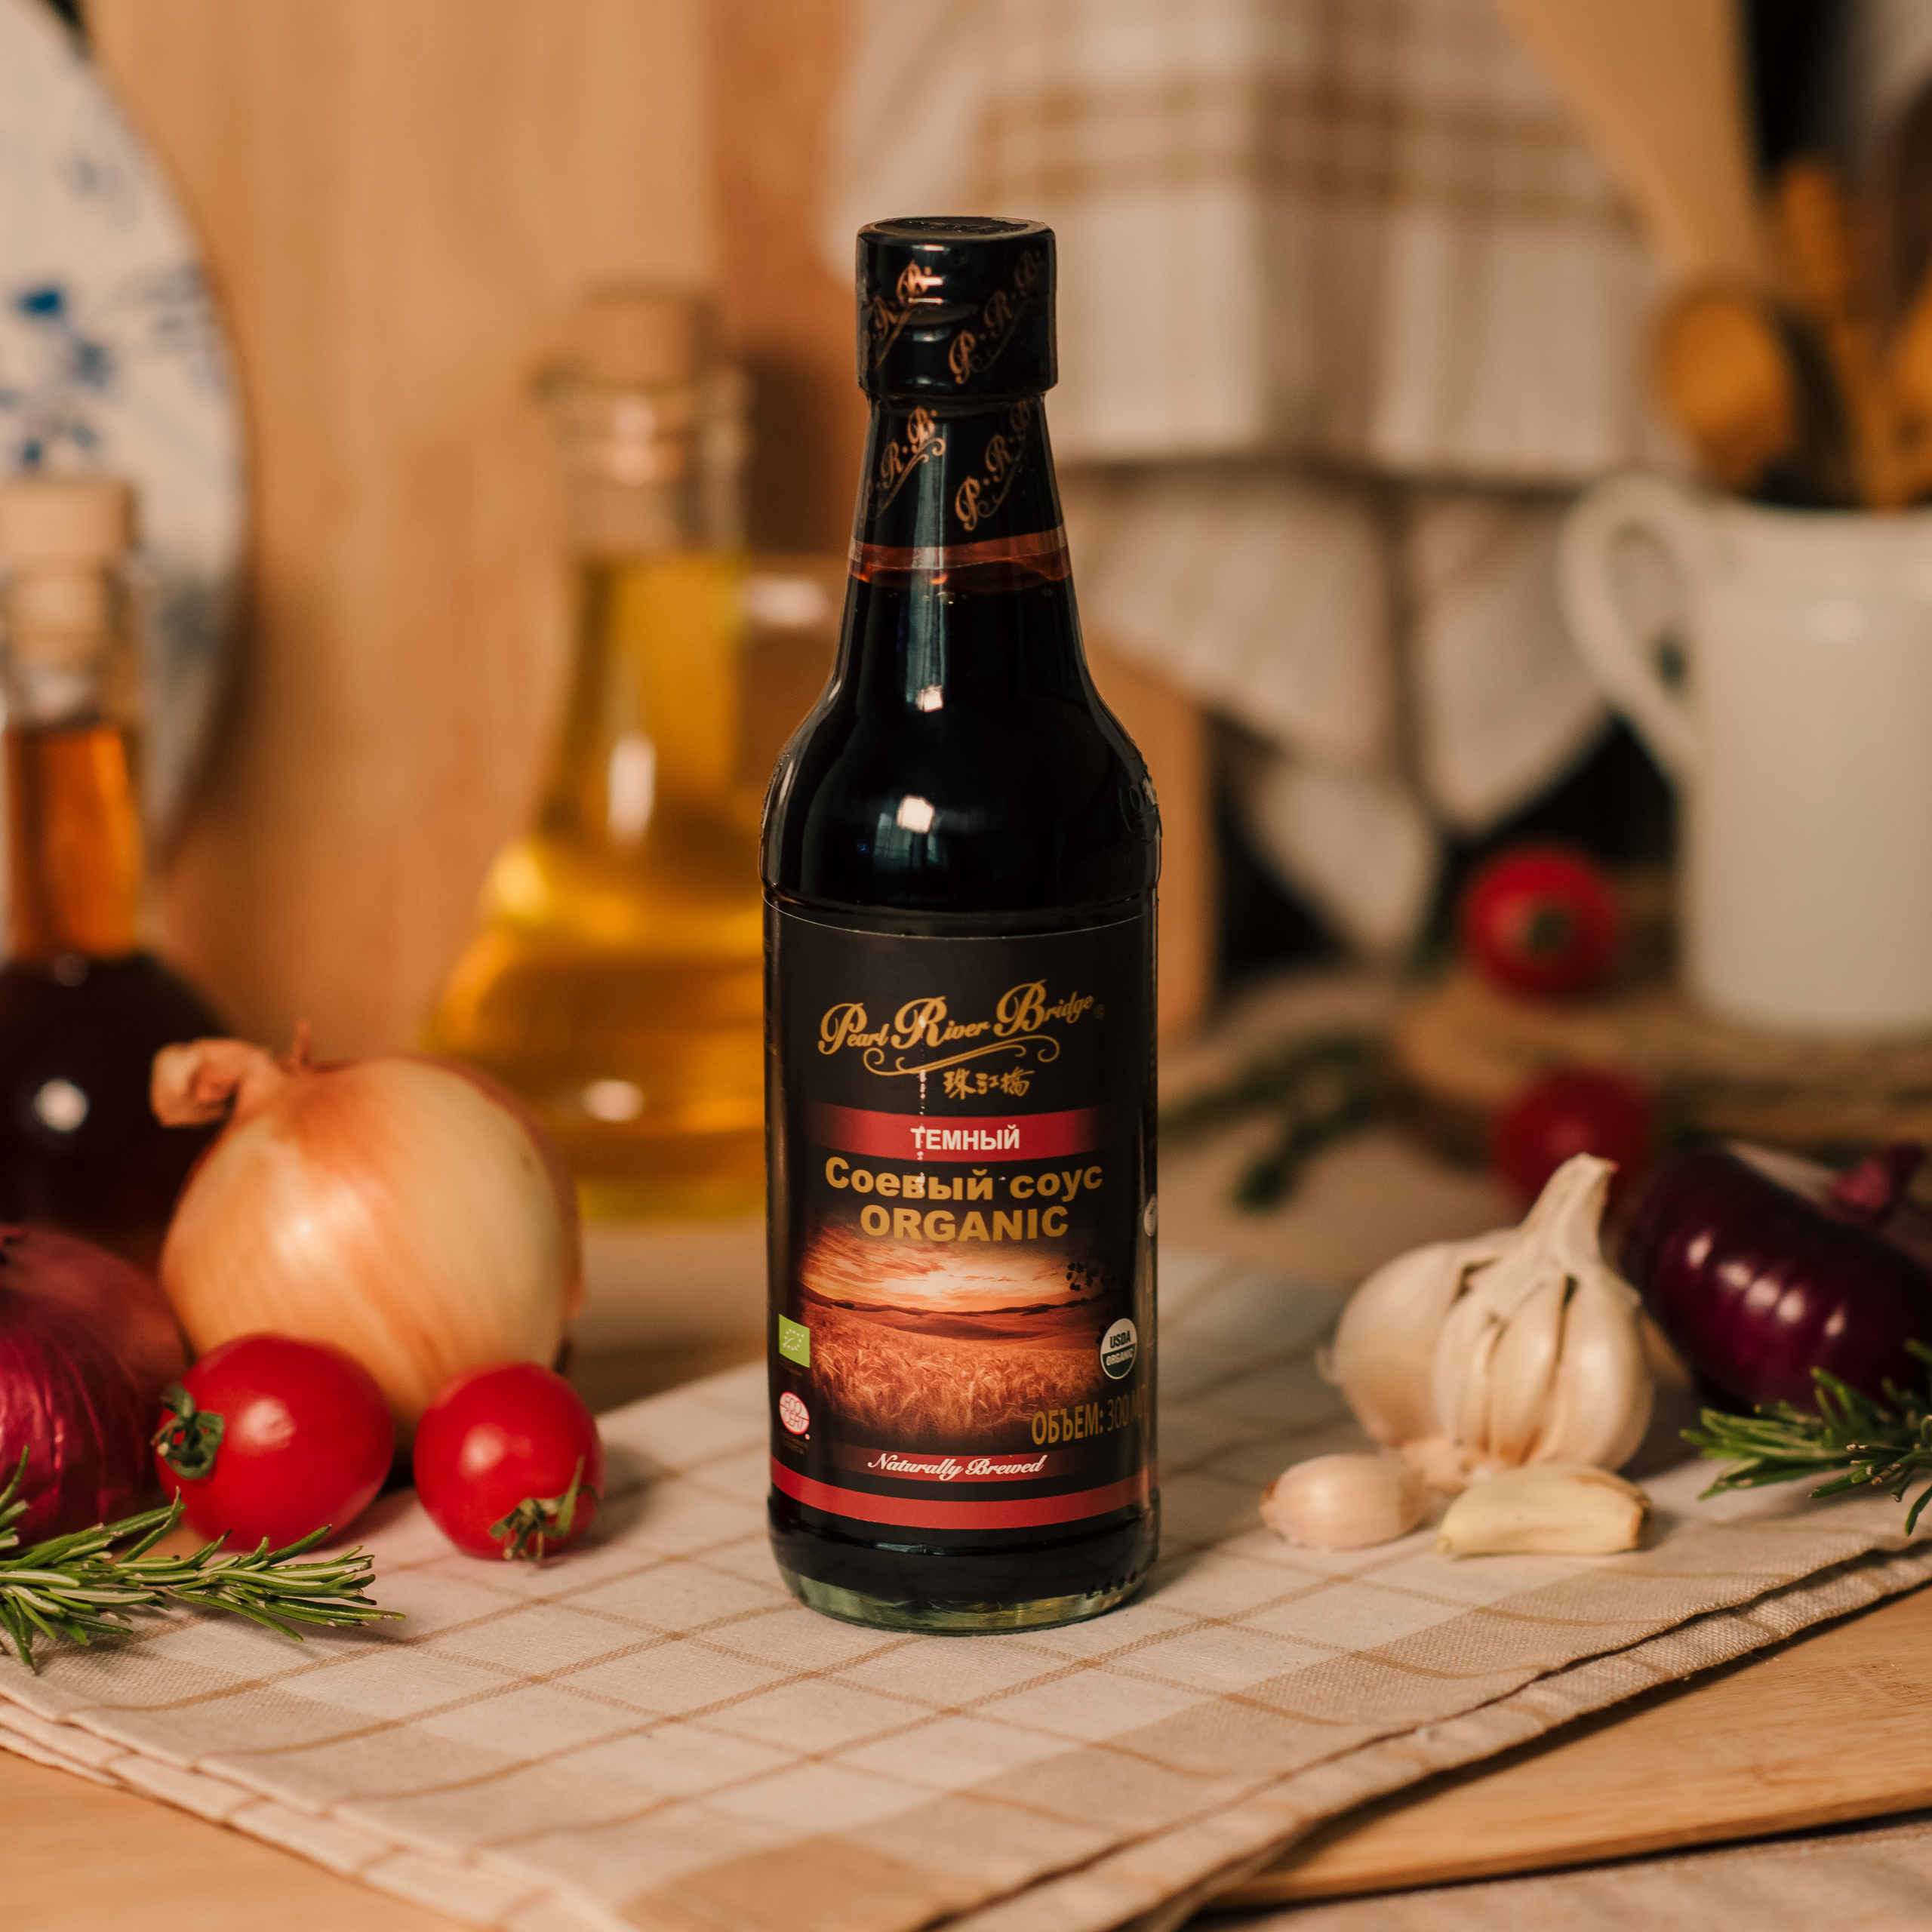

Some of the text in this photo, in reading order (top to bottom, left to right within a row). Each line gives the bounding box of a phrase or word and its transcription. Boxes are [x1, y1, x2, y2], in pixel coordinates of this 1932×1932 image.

[818, 979, 1094, 1055] Pearl River Bridge
[911, 1124, 1020, 1151] ТЕМНЫЙ
[825, 1156, 1103, 1201] Соевый соус
[860, 1204, 1069, 1242] ORGANIC
[1109, 1330, 1131, 1349] USDA
[1032, 1402, 1104, 1445] ОБЪЕМ:
[1106, 1393, 1130, 1432] 300
[867, 1453, 1047, 1481] Naturally Brewed
